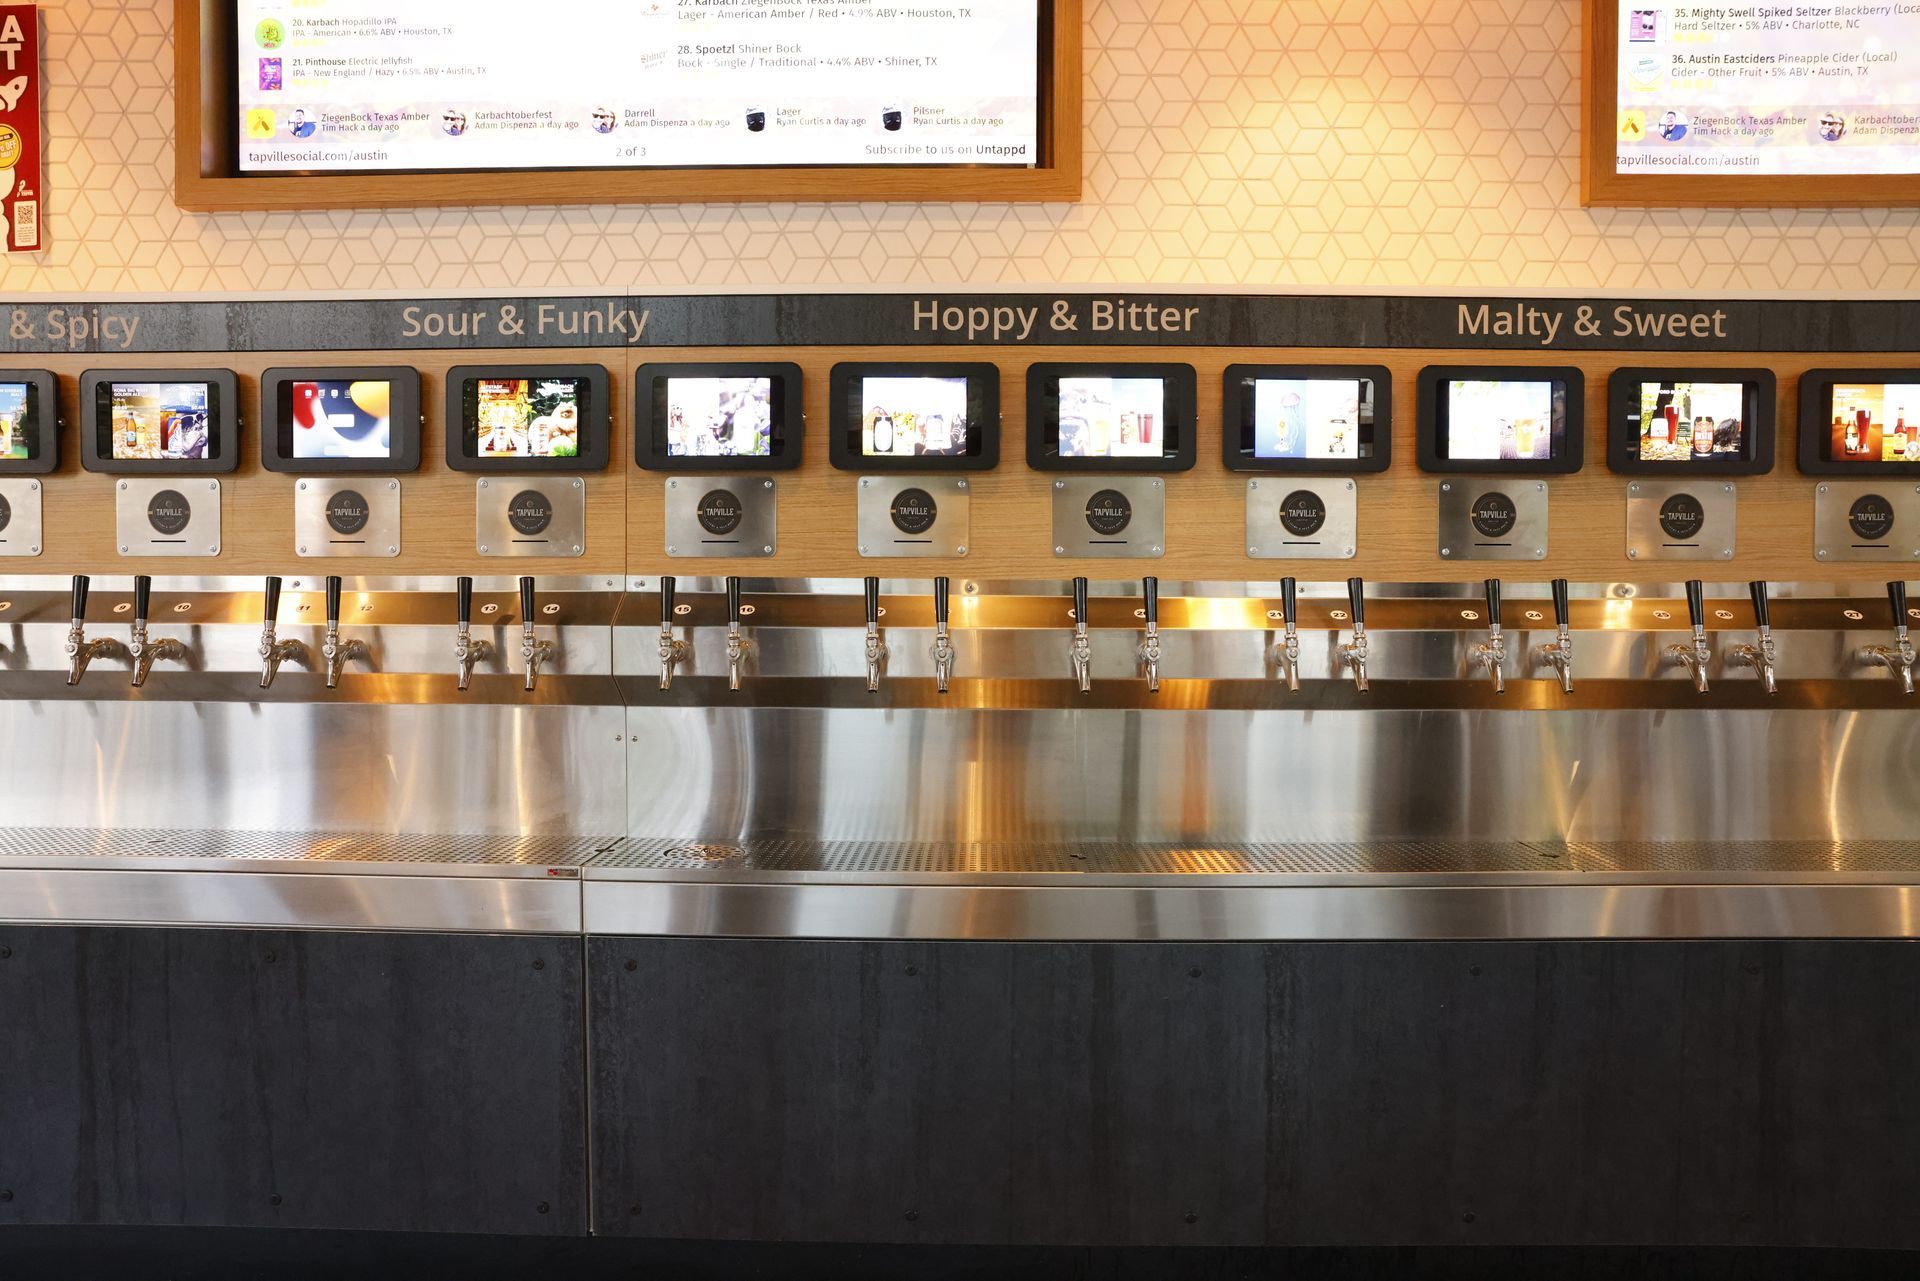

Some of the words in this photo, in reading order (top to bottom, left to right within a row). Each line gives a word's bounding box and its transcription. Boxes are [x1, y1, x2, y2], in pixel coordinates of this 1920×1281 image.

[678, 10, 706, 21] Lager
[718, 9, 767, 19] American
[770, 8, 805, 18] Amber
[818, 8, 838, 18] Red
[876, 9, 897, 18] ABV
[907, 8, 956, 19] Houston,
[958, 8, 972, 18] TX
[1675, 9, 1688, 17] 35.
[1692, 8, 1725, 20] Mighty
[1728, 8, 1755, 17] Swell
[1758, 7, 1792, 19] Spiked
[1796, 6, 1831, 16] Seltzer
[1835, 6, 1891, 16] Blackberry
[292, 18, 304, 26] 20.
[306, 18, 339, 26] Karbach
[342, 17, 382, 27] Hopadillo
[1674, 21, 1698, 30] Hard
[1702, 20, 1736, 30] Seltzer
[1746, 21, 1760, 30] 5%
[1762, 20, 1782, 30] ABV
[1792, 20, 1843, 31] Charlotte,
[1846, 20, 1860, 28] NC
[313, 29, 351, 37] American
[380, 28, 395, 36] ABV
[403, 27, 442, 37] Houston,
[442, 27, 452, 35] TX
[678, 46, 692, 54] 28.
[696, 44, 735, 56] Spoetzl
[739, 44, 772, 54] Shiner
[776, 44, 802, 53] Bock
[292, 58, 303, 66] 21.
[305, 58, 346, 67] Pinthouse
[348, 57, 379, 66] Electric
[381, 57, 412, 66] Jellyfish
[678, 58, 702, 68] Bock
[714, 58, 746, 70] Single
[759, 57, 816, 67] Traditional
[854, 57, 874, 66] ABV
[885, 56, 922, 67] Shiner,
[925, 57, 937, 66] TX
[1672, 55, 1686, 63] 36.
[1689, 54, 1720, 64] Austin
[1724, 53, 1775, 63] Eastciders
[1778, 52, 1829, 65] Pineapple
[1832, 52, 1859, 62] Cider
[1862, 51, 1898, 63] (Local)
[293, 69, 306, 77] IPA
[314, 69, 331, 77] New
[334, 68, 366, 78] England
[375, 68, 395, 78] Hazy
[423, 67, 439, 76] ABV
[446, 67, 476, 77] Austin,
[477, 66, 487, 75] TX
[1672, 68, 1697, 77] Cider
[1708, 68, 1736, 77] Other
[1739, 68, 1762, 76] Fruit
[1772, 68, 1786, 76] 5%
[1789, 67, 1809, 76] ABV
[1818, 66, 1854, 78] Austin,
[1857, 66, 1869, 76] TX
[475, 111, 552, 120] Karbachtoberfest
[625, 109, 655, 118] Darrell
[776, 108, 801, 118] Lager
[913, 106, 944, 115] Pilsner
[321, 113, 371, 123] ZiegenBock
[374, 112, 398, 122] Texas
[401, 112, 429, 121] Amber
[776, 117, 797, 127] Ryan
[834, 117, 849, 127] day
[851, 118, 866, 127] ago
[971, 116, 986, 127] day
[988, 118, 1004, 127] ago
[1693, 116, 1746, 127] ZiegenBock
[1749, 116, 1773, 125] Texas
[1776, 116, 1806, 125] Amber
[1854, 115, 1920, 124] Karbachtober
[321, 123, 336, 132] Tim
[338, 123, 359, 132] Hack
[368, 123, 381, 134] day
[383, 125, 399, 133] ago
[475, 121, 497, 129] Adam
[500, 121, 538, 130] Dispenza
[547, 120, 561, 129] day
[564, 121, 579, 129] ago
[624, 118, 648, 127] Adam
[650, 118, 688, 129] Dispenza
[698, 118, 712, 129] day
[715, 121, 730, 129] ago
[1693, 127, 1708, 136] Tim
[1710, 127, 1731, 136] Hack
[1742, 127, 1756, 138] day
[1758, 129, 1774, 138] ago
[1880, 126, 1920, 136] Dispenza
[616, 148, 622, 157] 2
[625, 147, 637, 156] of
[640, 147, 646, 156] 3
[865, 144, 922, 154] Subscribe
[926, 145, 937, 154] to
[976, 144, 1026, 156] Untappd
[249, 151, 388, 163] tapvillesocial.com/austin
[1617, 154, 1760, 167] tapvillesocial.com/austin
[402, 306, 486, 337] Sour
[498, 304, 524, 335] &
[538, 302, 649, 342] Funky
[913, 300, 1038, 340] Hoppy
[1050, 300, 1078, 331] &
[1092, 299, 1199, 332] Bitter
[1458, 303, 1562, 345] Malty
[1574, 305, 1601, 336] &
[1613, 305, 1726, 338] Sweet
[10, 310, 36, 339] &
[47, 309, 140, 348] Spicy
[156, 508, 182, 516] TAPVILLE
[334, 508, 360, 516] TAPVILLE
[517, 509, 544, 517] TAPVILLE
[706, 508, 734, 516] TAPVILLE
[900, 507, 928, 515] TAPVILLE
[1094, 508, 1122, 516] TAPVILLE
[1288, 510, 1316, 518] TAPVILLE
[1480, 510, 1507, 519] TAPVILLE
[1668, 512, 1695, 520] TAPVILLE
[1857, 513, 1885, 521] TAPVILLE
